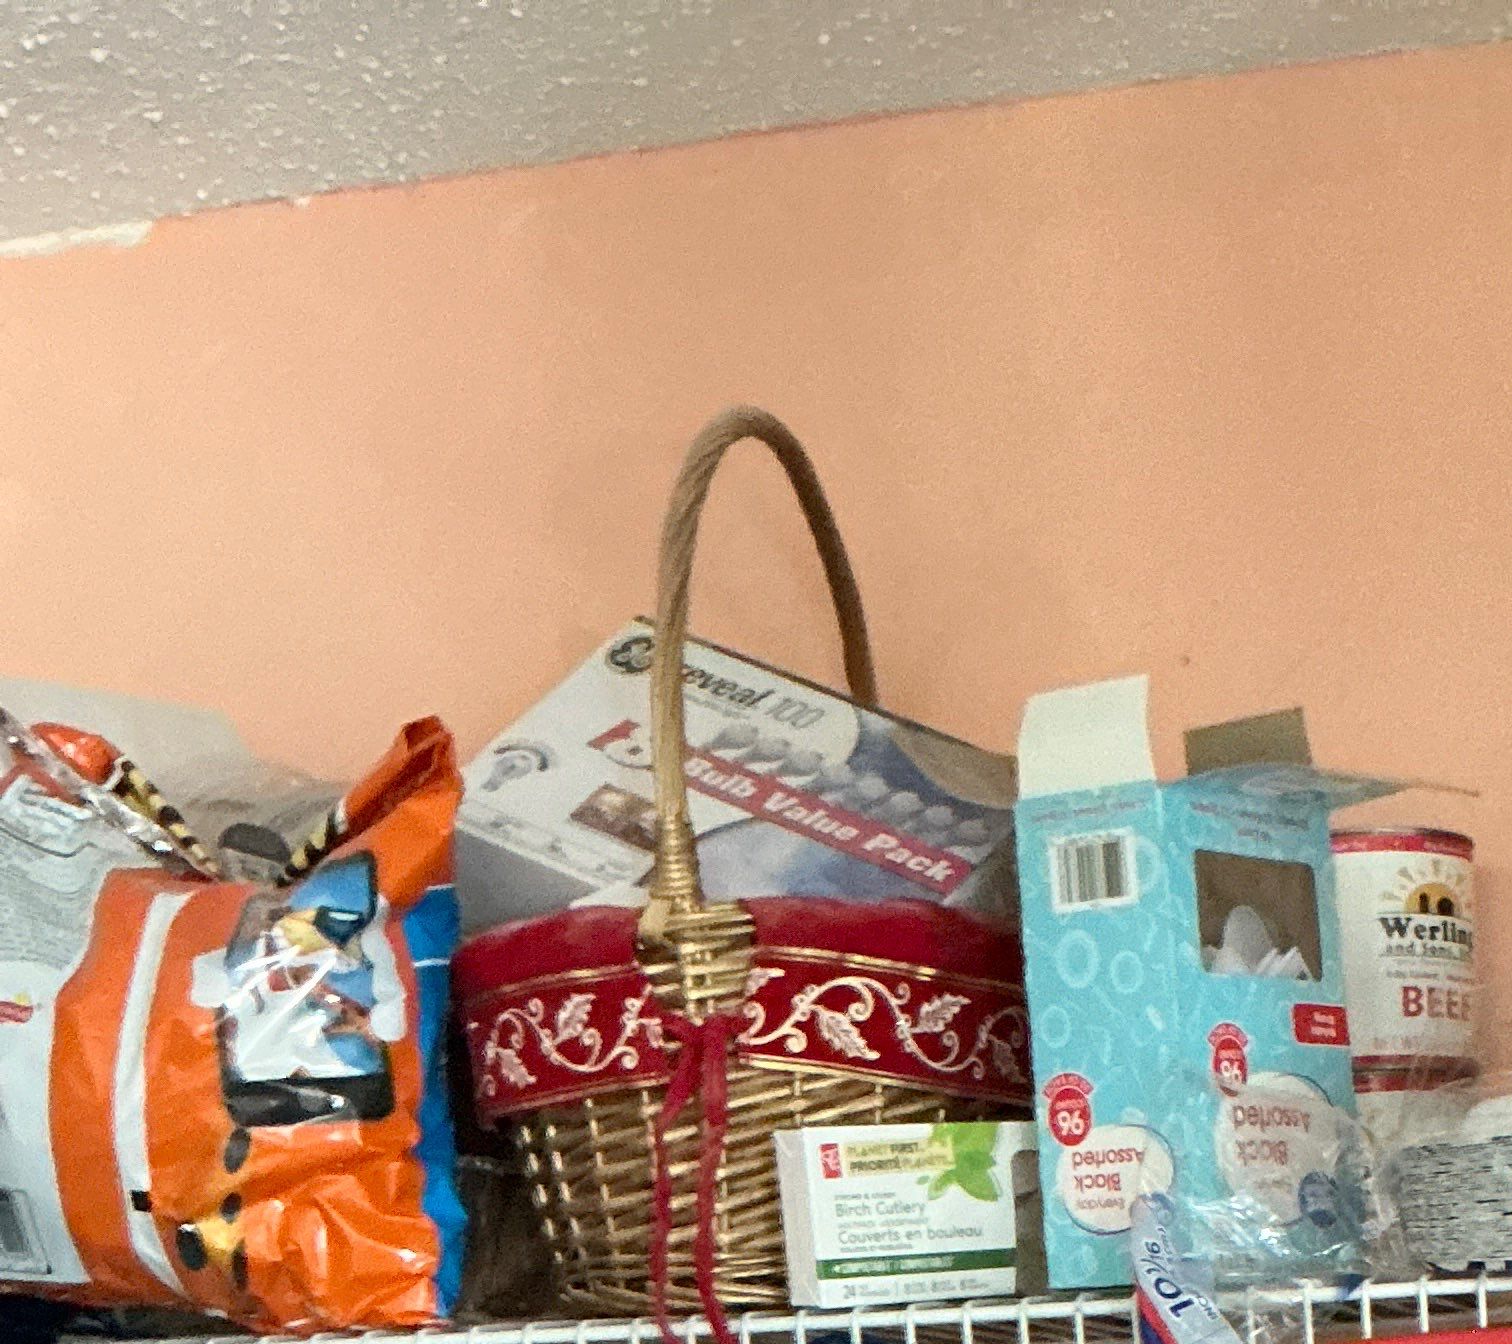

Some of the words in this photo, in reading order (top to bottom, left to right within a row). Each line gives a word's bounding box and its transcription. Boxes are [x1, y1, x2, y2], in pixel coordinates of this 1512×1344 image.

[763, 788, 855, 843] Value
[862, 830, 954, 882] Pack
[1056, 1111, 1083, 1136] 96
[1071, 1146, 1147, 1169] Assorted
[835, 1202, 872, 1218] Birch
[876, 1201, 926, 1218] Cutlery
[838, 1228, 900, 1245] Couverts
[905, 1229, 921, 1241] en
[927, 1225, 983, 1241] bouleau
